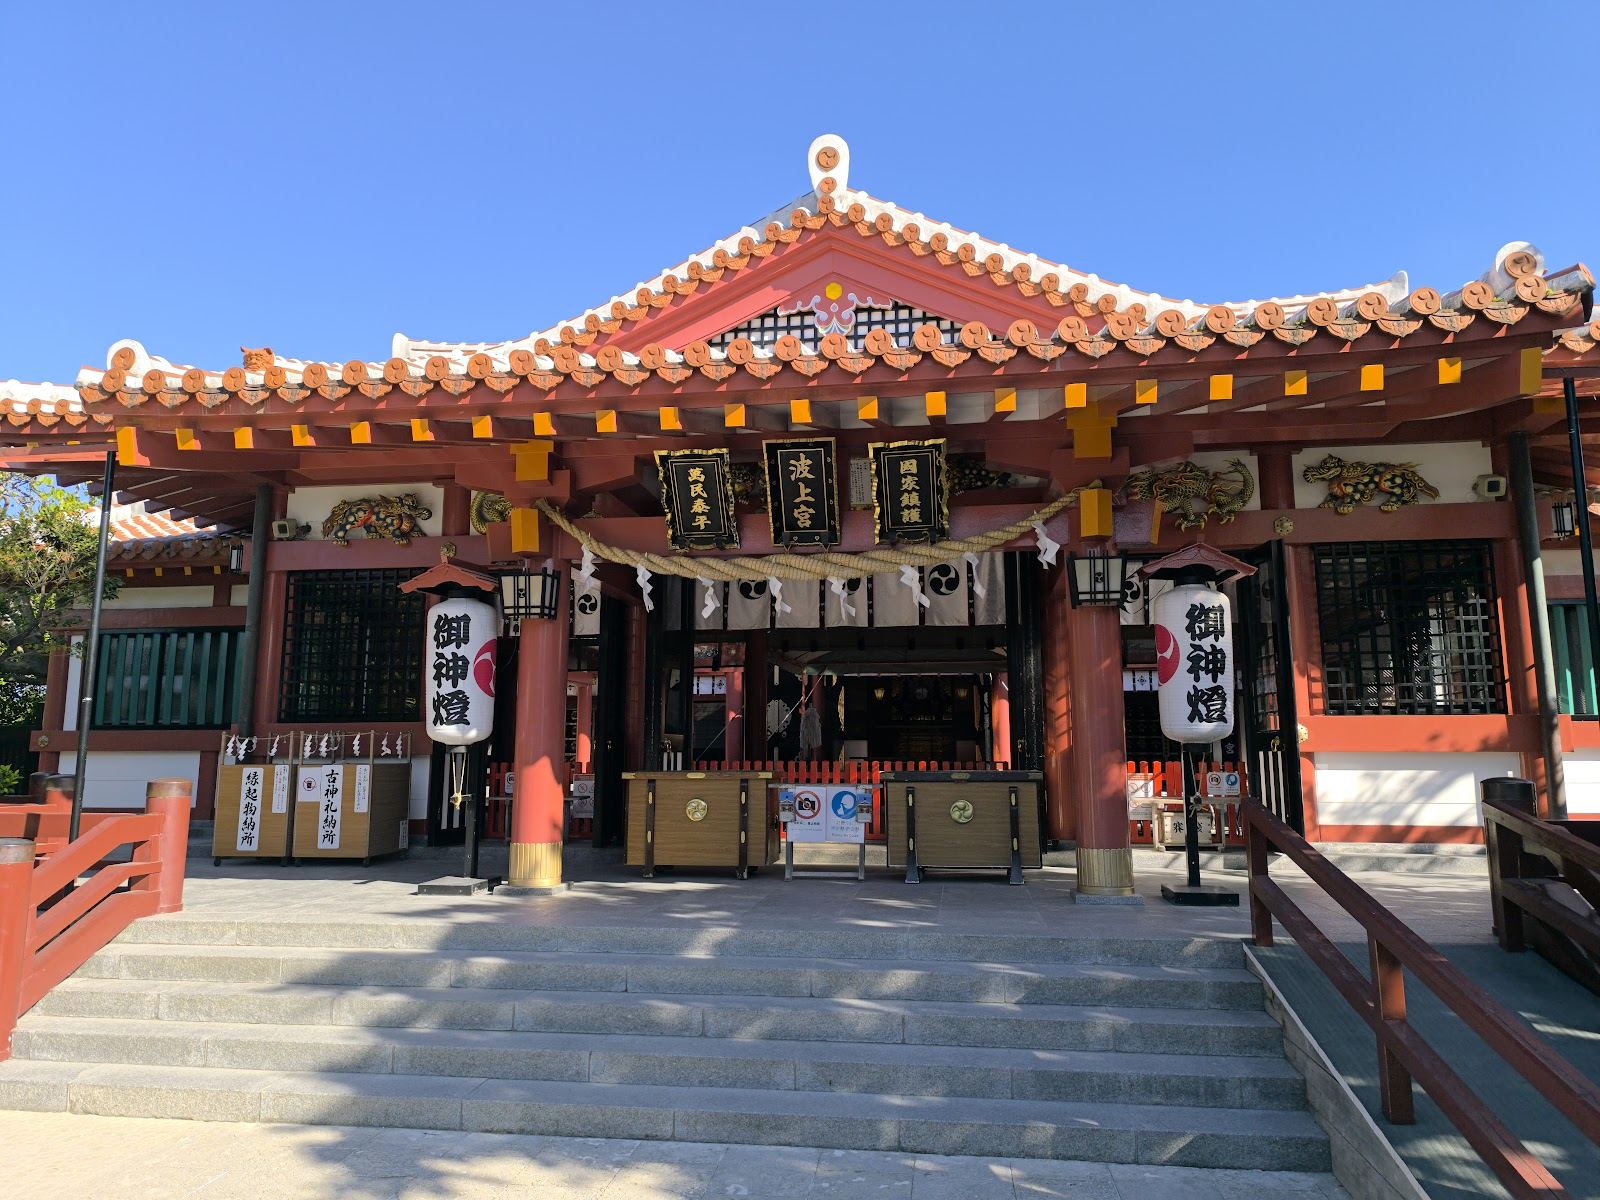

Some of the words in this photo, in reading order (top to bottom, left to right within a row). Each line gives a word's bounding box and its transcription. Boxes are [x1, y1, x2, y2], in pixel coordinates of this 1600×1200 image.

[789, 453, 815, 528] 波上宮
[433, 613, 469, 726] 御神燈
[1185, 603, 1227, 723] 御神燈
